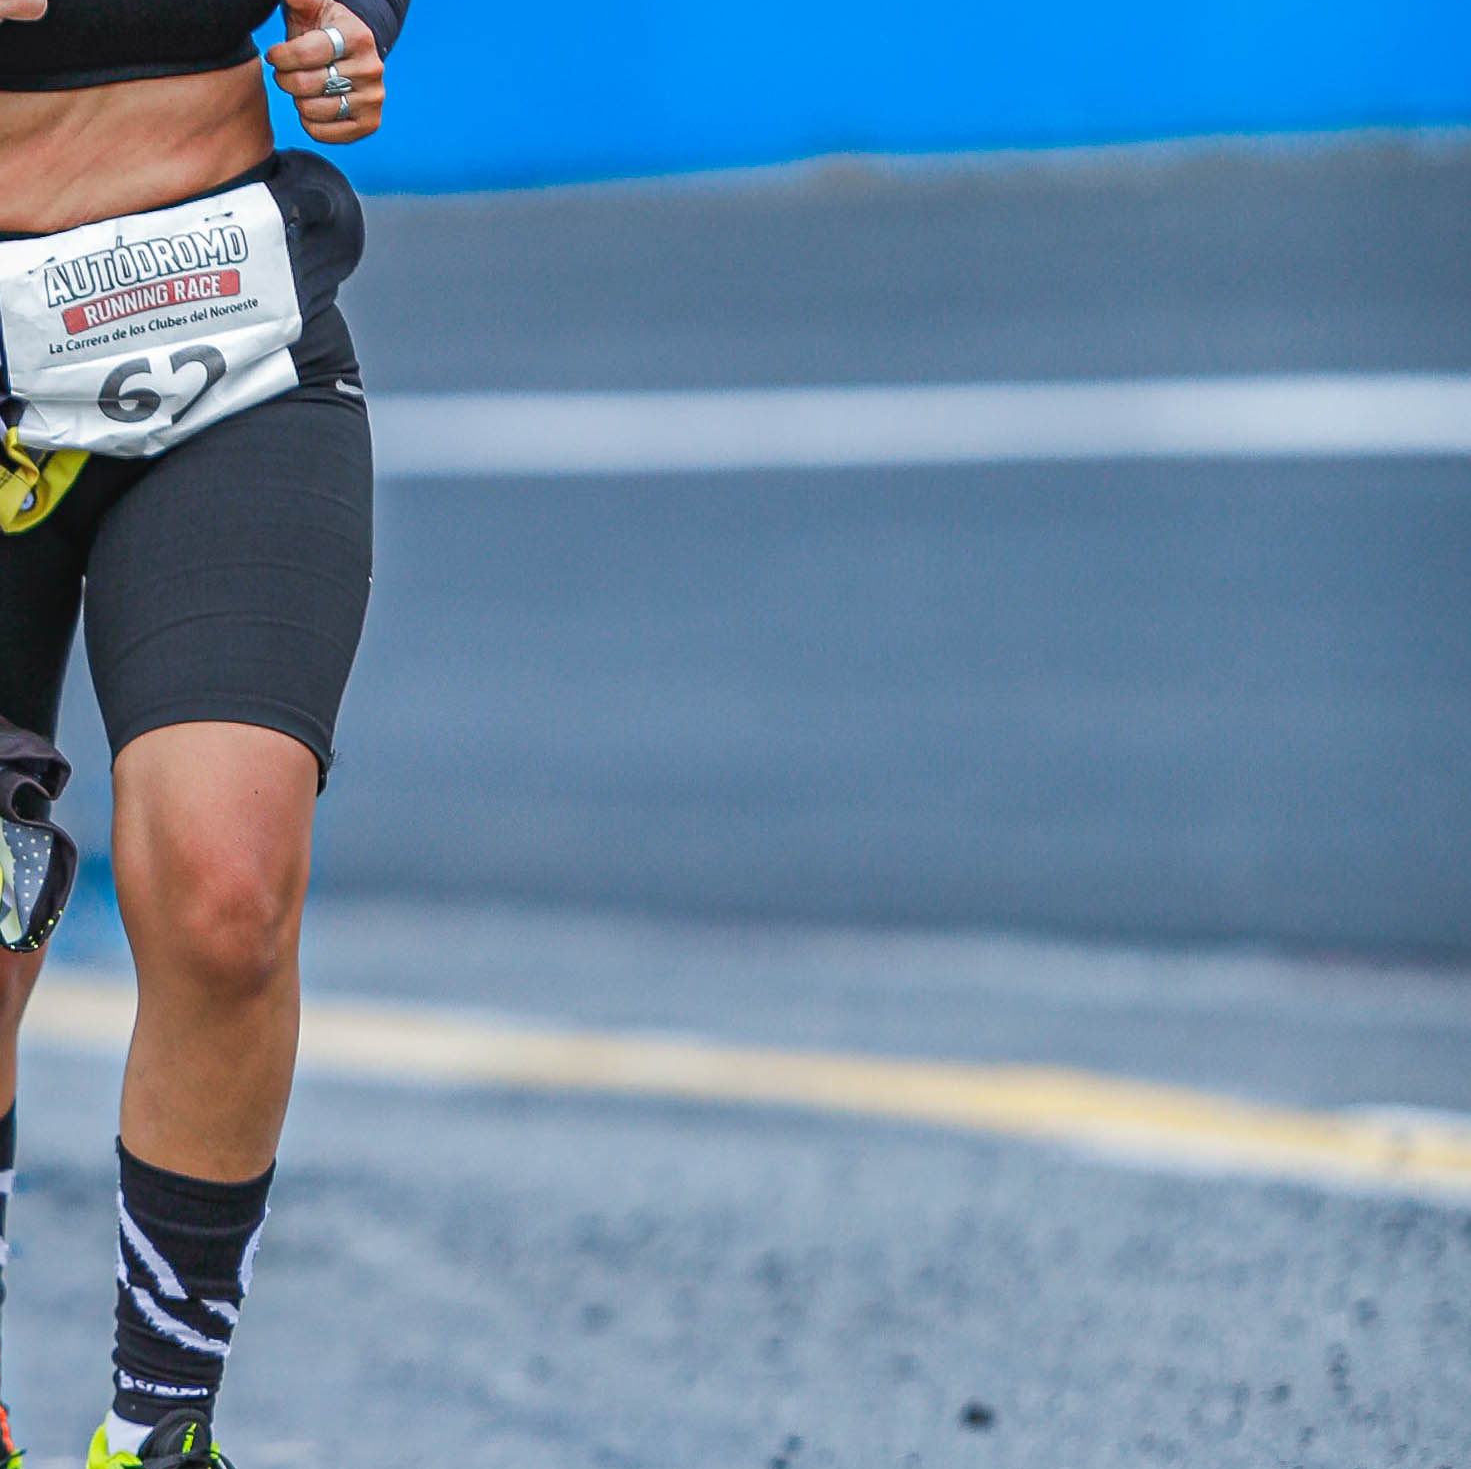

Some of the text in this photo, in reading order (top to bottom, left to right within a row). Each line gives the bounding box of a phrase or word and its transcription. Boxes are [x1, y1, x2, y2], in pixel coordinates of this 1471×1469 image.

[44, 225, 248, 308] AUTÓDROMO
[83, 274, 221, 327] RUNNING RACE
[49, 298, 259, 355] La Carrera de los Clubes del Noroeste
[97, 344, 227, 425] 62
